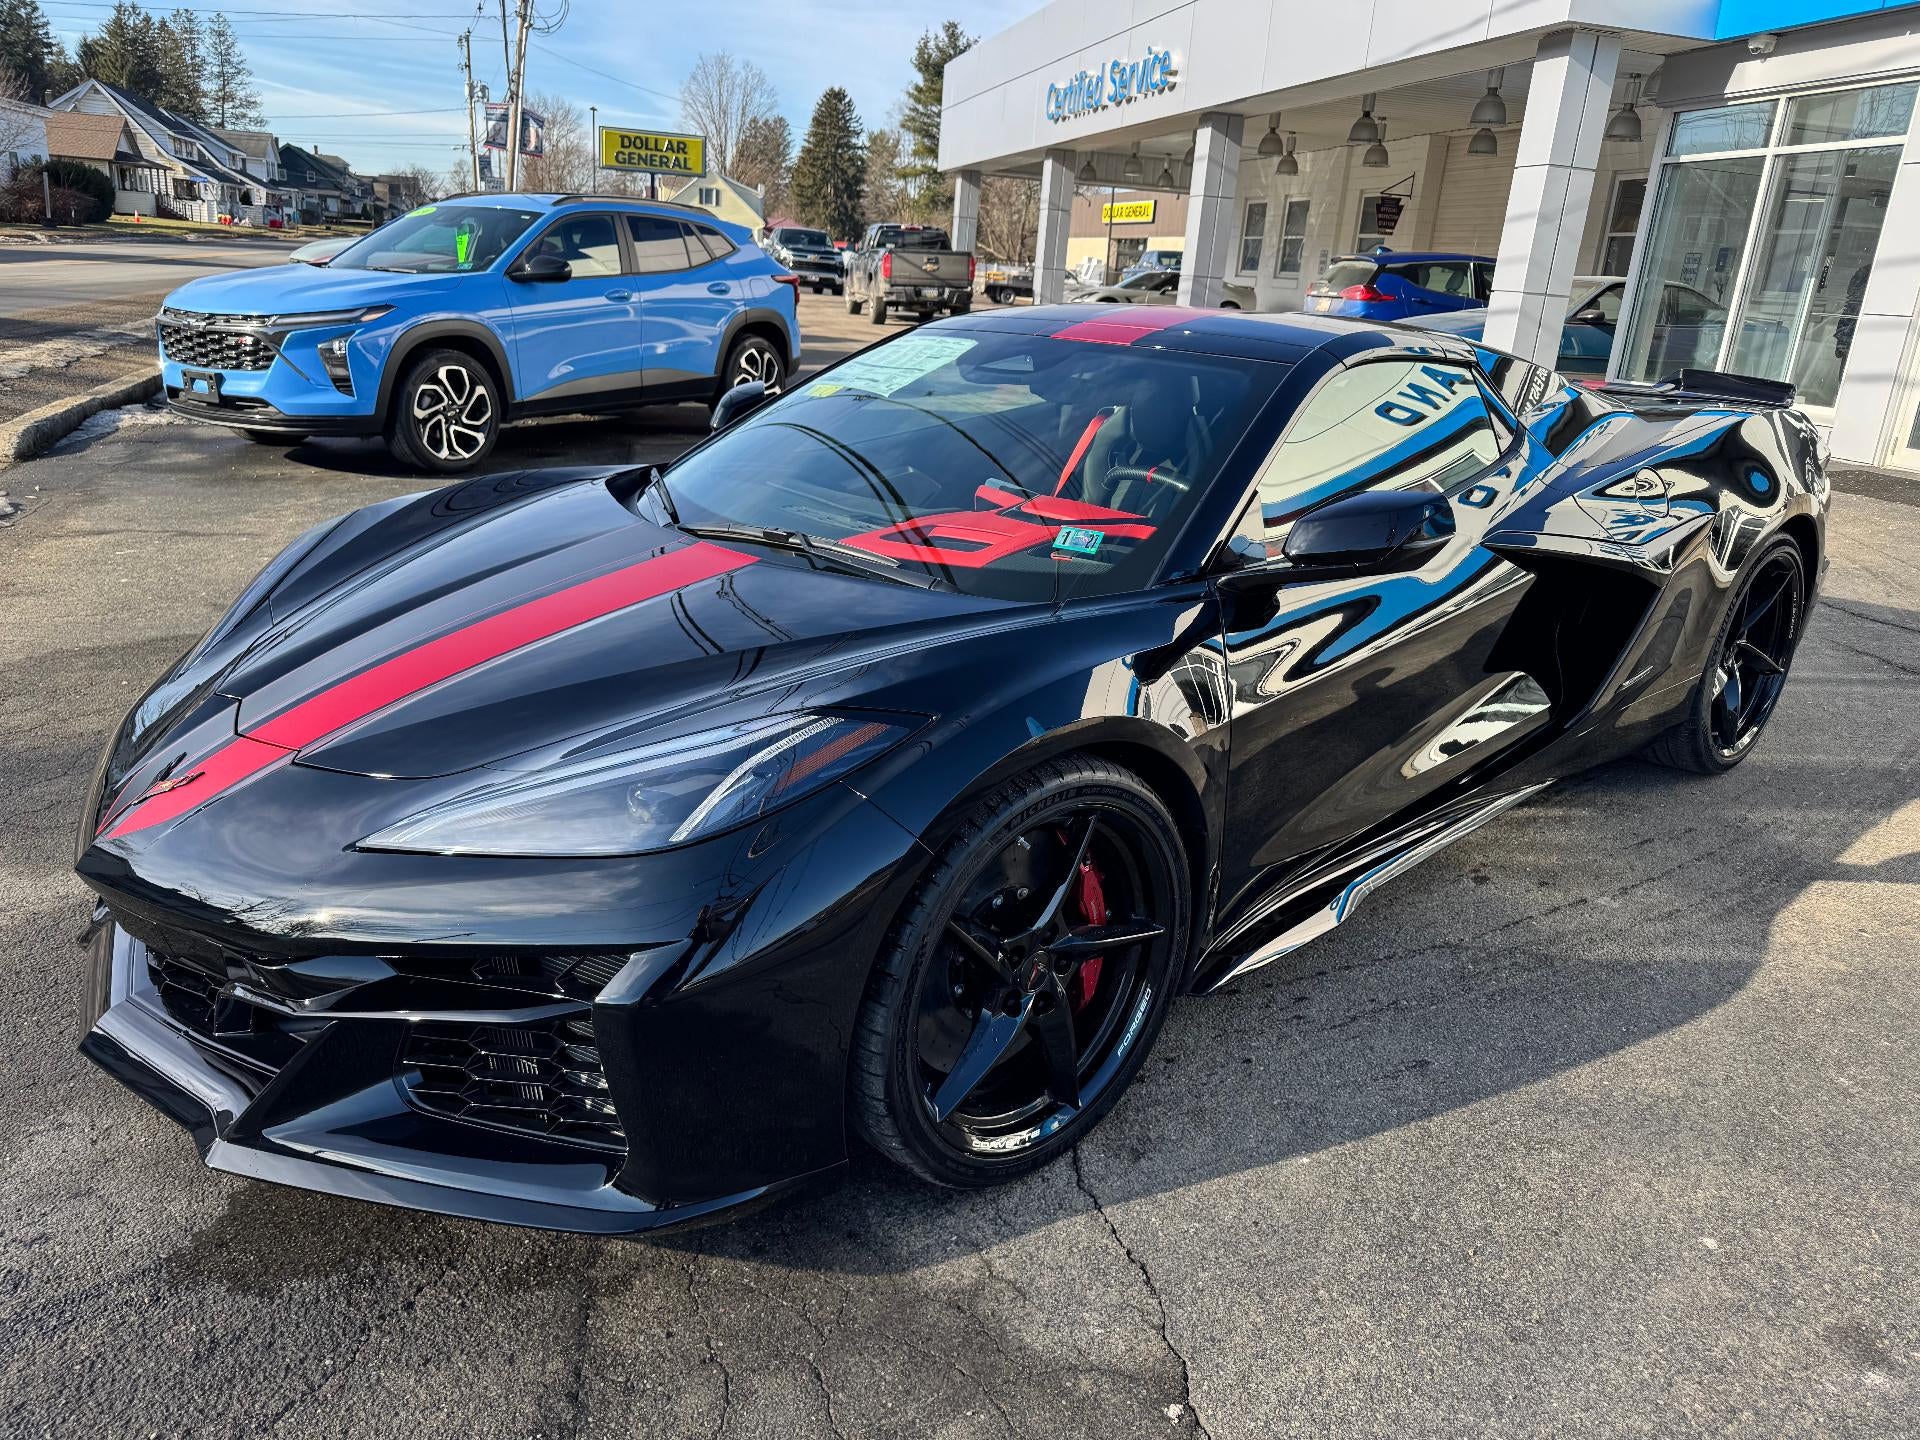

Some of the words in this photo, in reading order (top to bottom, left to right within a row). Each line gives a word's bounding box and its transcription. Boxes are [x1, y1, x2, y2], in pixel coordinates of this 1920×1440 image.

[1047, 63, 1105, 120] Certified
[1107, 46, 1171, 102] Service
[614, 150, 692, 170] GENERAL
[619, 134, 688, 154] DOLLAR
[1009, 788, 1078, 830] MICHELIN
[1117, 987, 1152, 1058] FORGED
[971, 1127, 1041, 1151] CORVETTE
